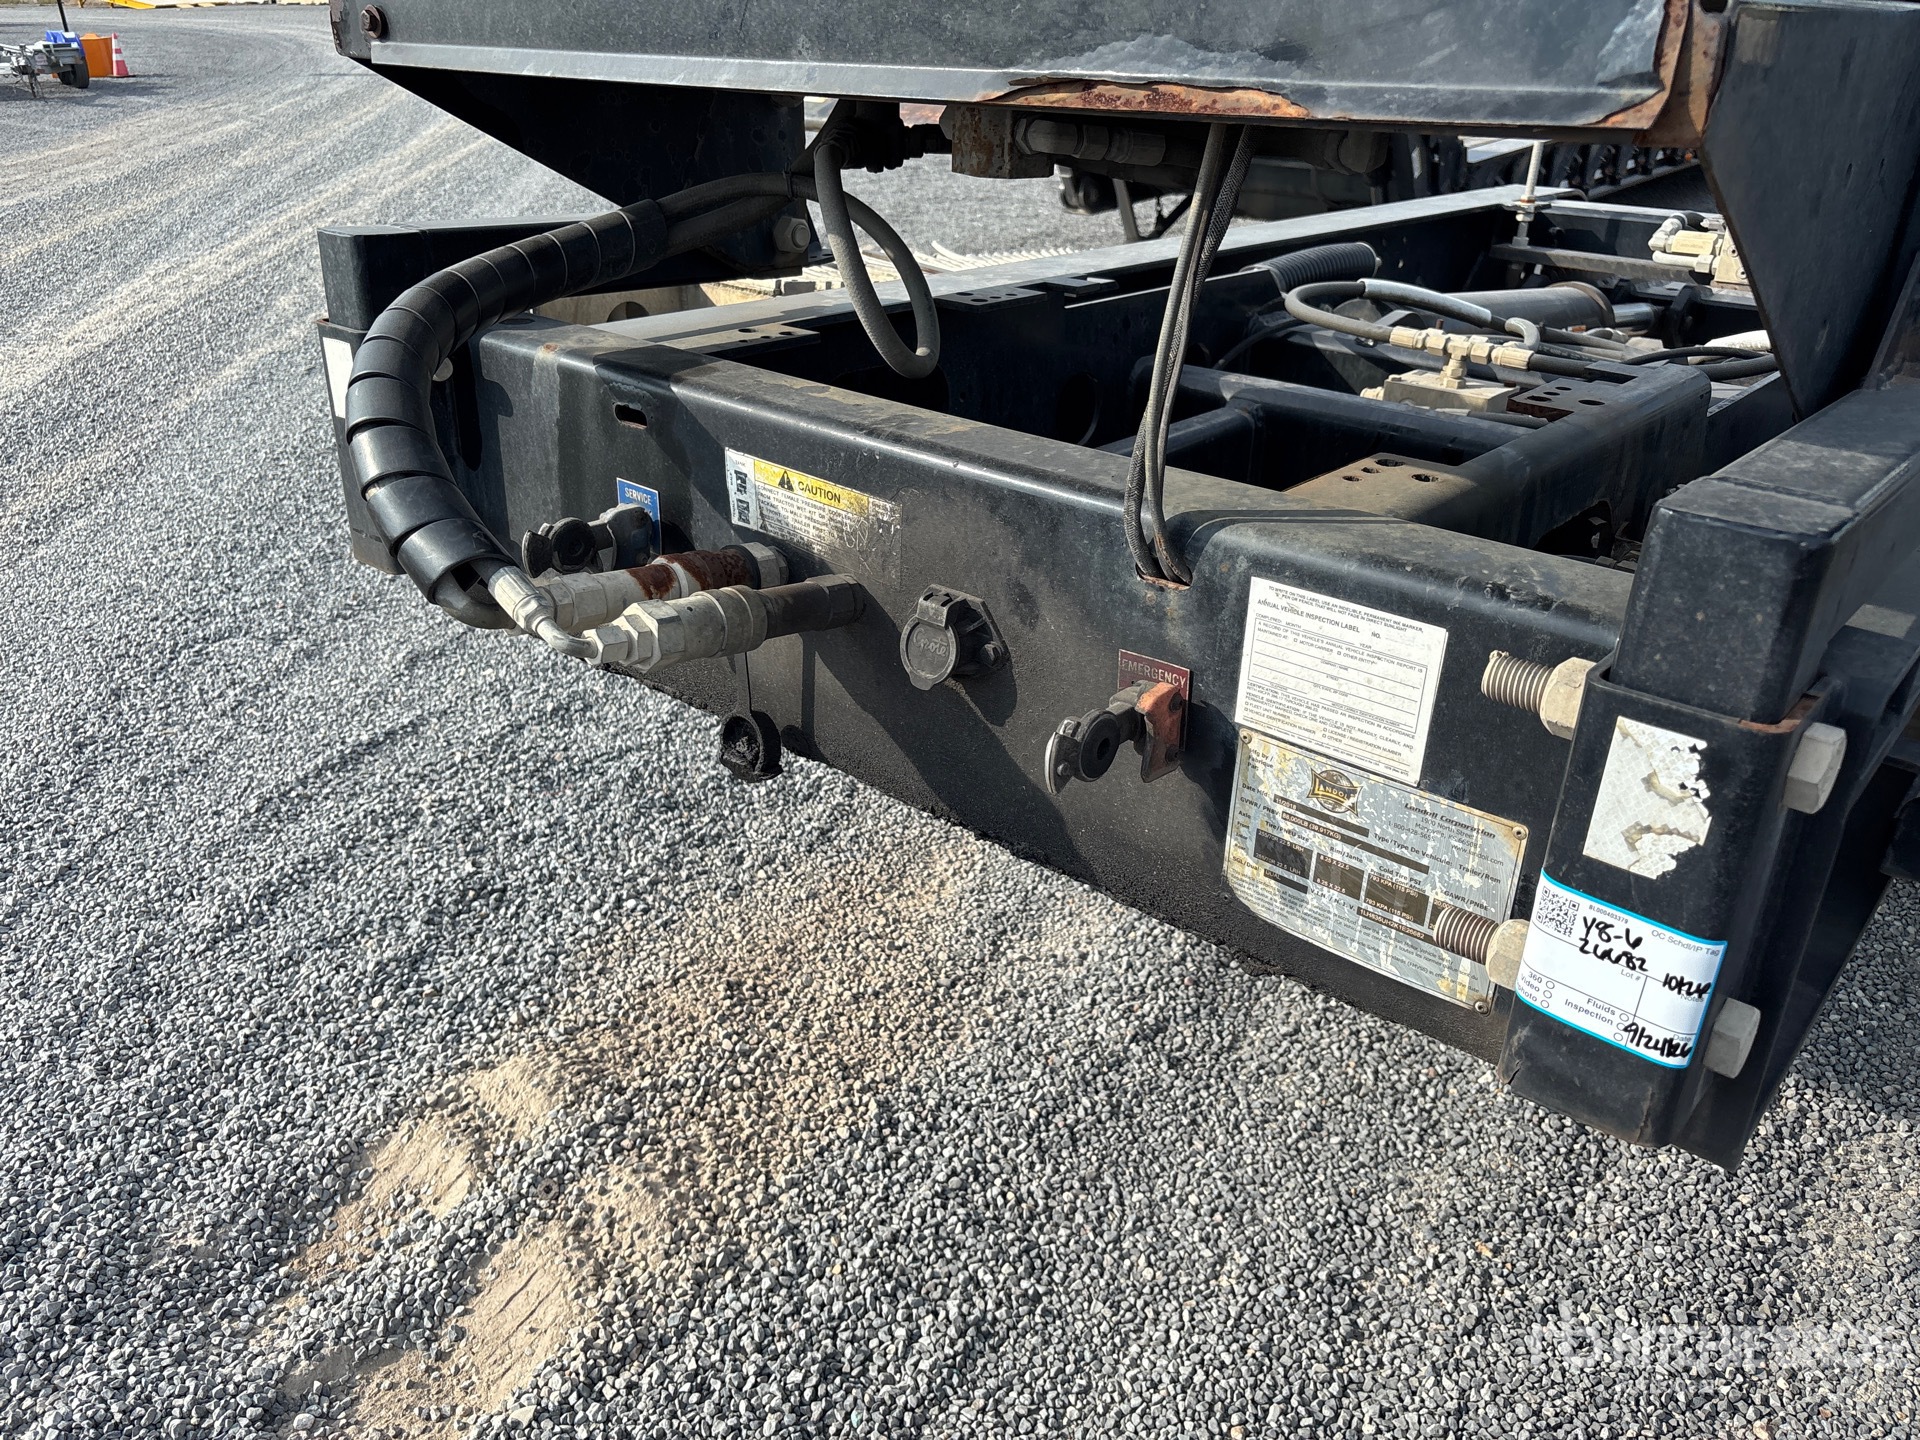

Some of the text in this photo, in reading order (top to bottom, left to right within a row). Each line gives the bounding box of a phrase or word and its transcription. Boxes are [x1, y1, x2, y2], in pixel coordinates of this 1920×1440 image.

[624, 488, 652, 506] SERVICE
[758, 485, 779, 496] CONNECT
[782, 492, 800, 504] FEMALE
[773, 497, 794, 508] TRACTOR
[798, 482, 840, 504] CAUTION
[1257, 598, 1381, 638] ANNUAL VEHICLE INSPECTION LABEL NO.
[1285, 621, 1301, 629] MONTH
[914, 628, 948, 656] Grote
[1257, 627, 1281, 637] MAINTAINED
[1314, 644, 1333, 653] CARRIER
[1262, 622, 1281, 631] RECORD
[1325, 640, 1343, 649] ANNUAL
[1345, 646, 1364, 656] VEHICLE
[1366, 652, 1394, 664] INSPECTION
[1396, 661, 1416, 671] REPORT
[1122, 659, 1186, 688] EMERGENCY
[1248, 708, 1265, 717] VEHICLE
[1266, 714, 1297, 728] IDENTIFICATION
[1291, 695, 1308, 704] VEHICLE
[1320, 705, 1338, 714] PASSED
[1348, 714, 1375, 726] INSPECTION
[1382, 725, 1415, 739] ACCORDANCE
[1318, 715, 1337, 724] VEHICLE
[1326, 734, 1342, 743] OTHER
[1327, 728, 1346, 738] LICENSE
[1349, 736, 1381, 750] REGISTRATION
[1382, 747, 1401, 757] NUMBER
[1242, 782, 1255, 792] Date
[1404, 802, 1496, 840] Landoll Corporation
[1420, 816, 1435, 826] 1900
[1437, 822, 1454, 833] North
[1297, 833, 1309, 843] size
[1329, 846, 1363, 864] Rim/Jante
[1373, 832, 1408, 850] Type/Type
[1410, 846, 1420, 855] De
[1457, 863, 1501, 885] Trailer/Rem
[1265, 869, 1280, 880] DUAL
[1378, 864, 1421, 886] Cold Tire PSI
[1380, 878, 1392, 887] KPA
[1443, 889, 1488, 912] GAWR/PNBE
[1376, 902, 1388, 911] KPA
[1388, 907, 1400, 916] (115
[1401, 912, 1414, 922] PSI)
[1652, 928, 1666, 939] OC
[1705, 947, 1720, 957] Tag
[1521, 973, 1540, 992] Video
[1528, 971, 1543, 984] 360
[1620, 969, 1634, 979] Lot
[1564, 999, 1614, 1026] Inspection
[1586, 998, 1616, 1016] Fluids
[1672, 1034, 1692, 1042] Date
